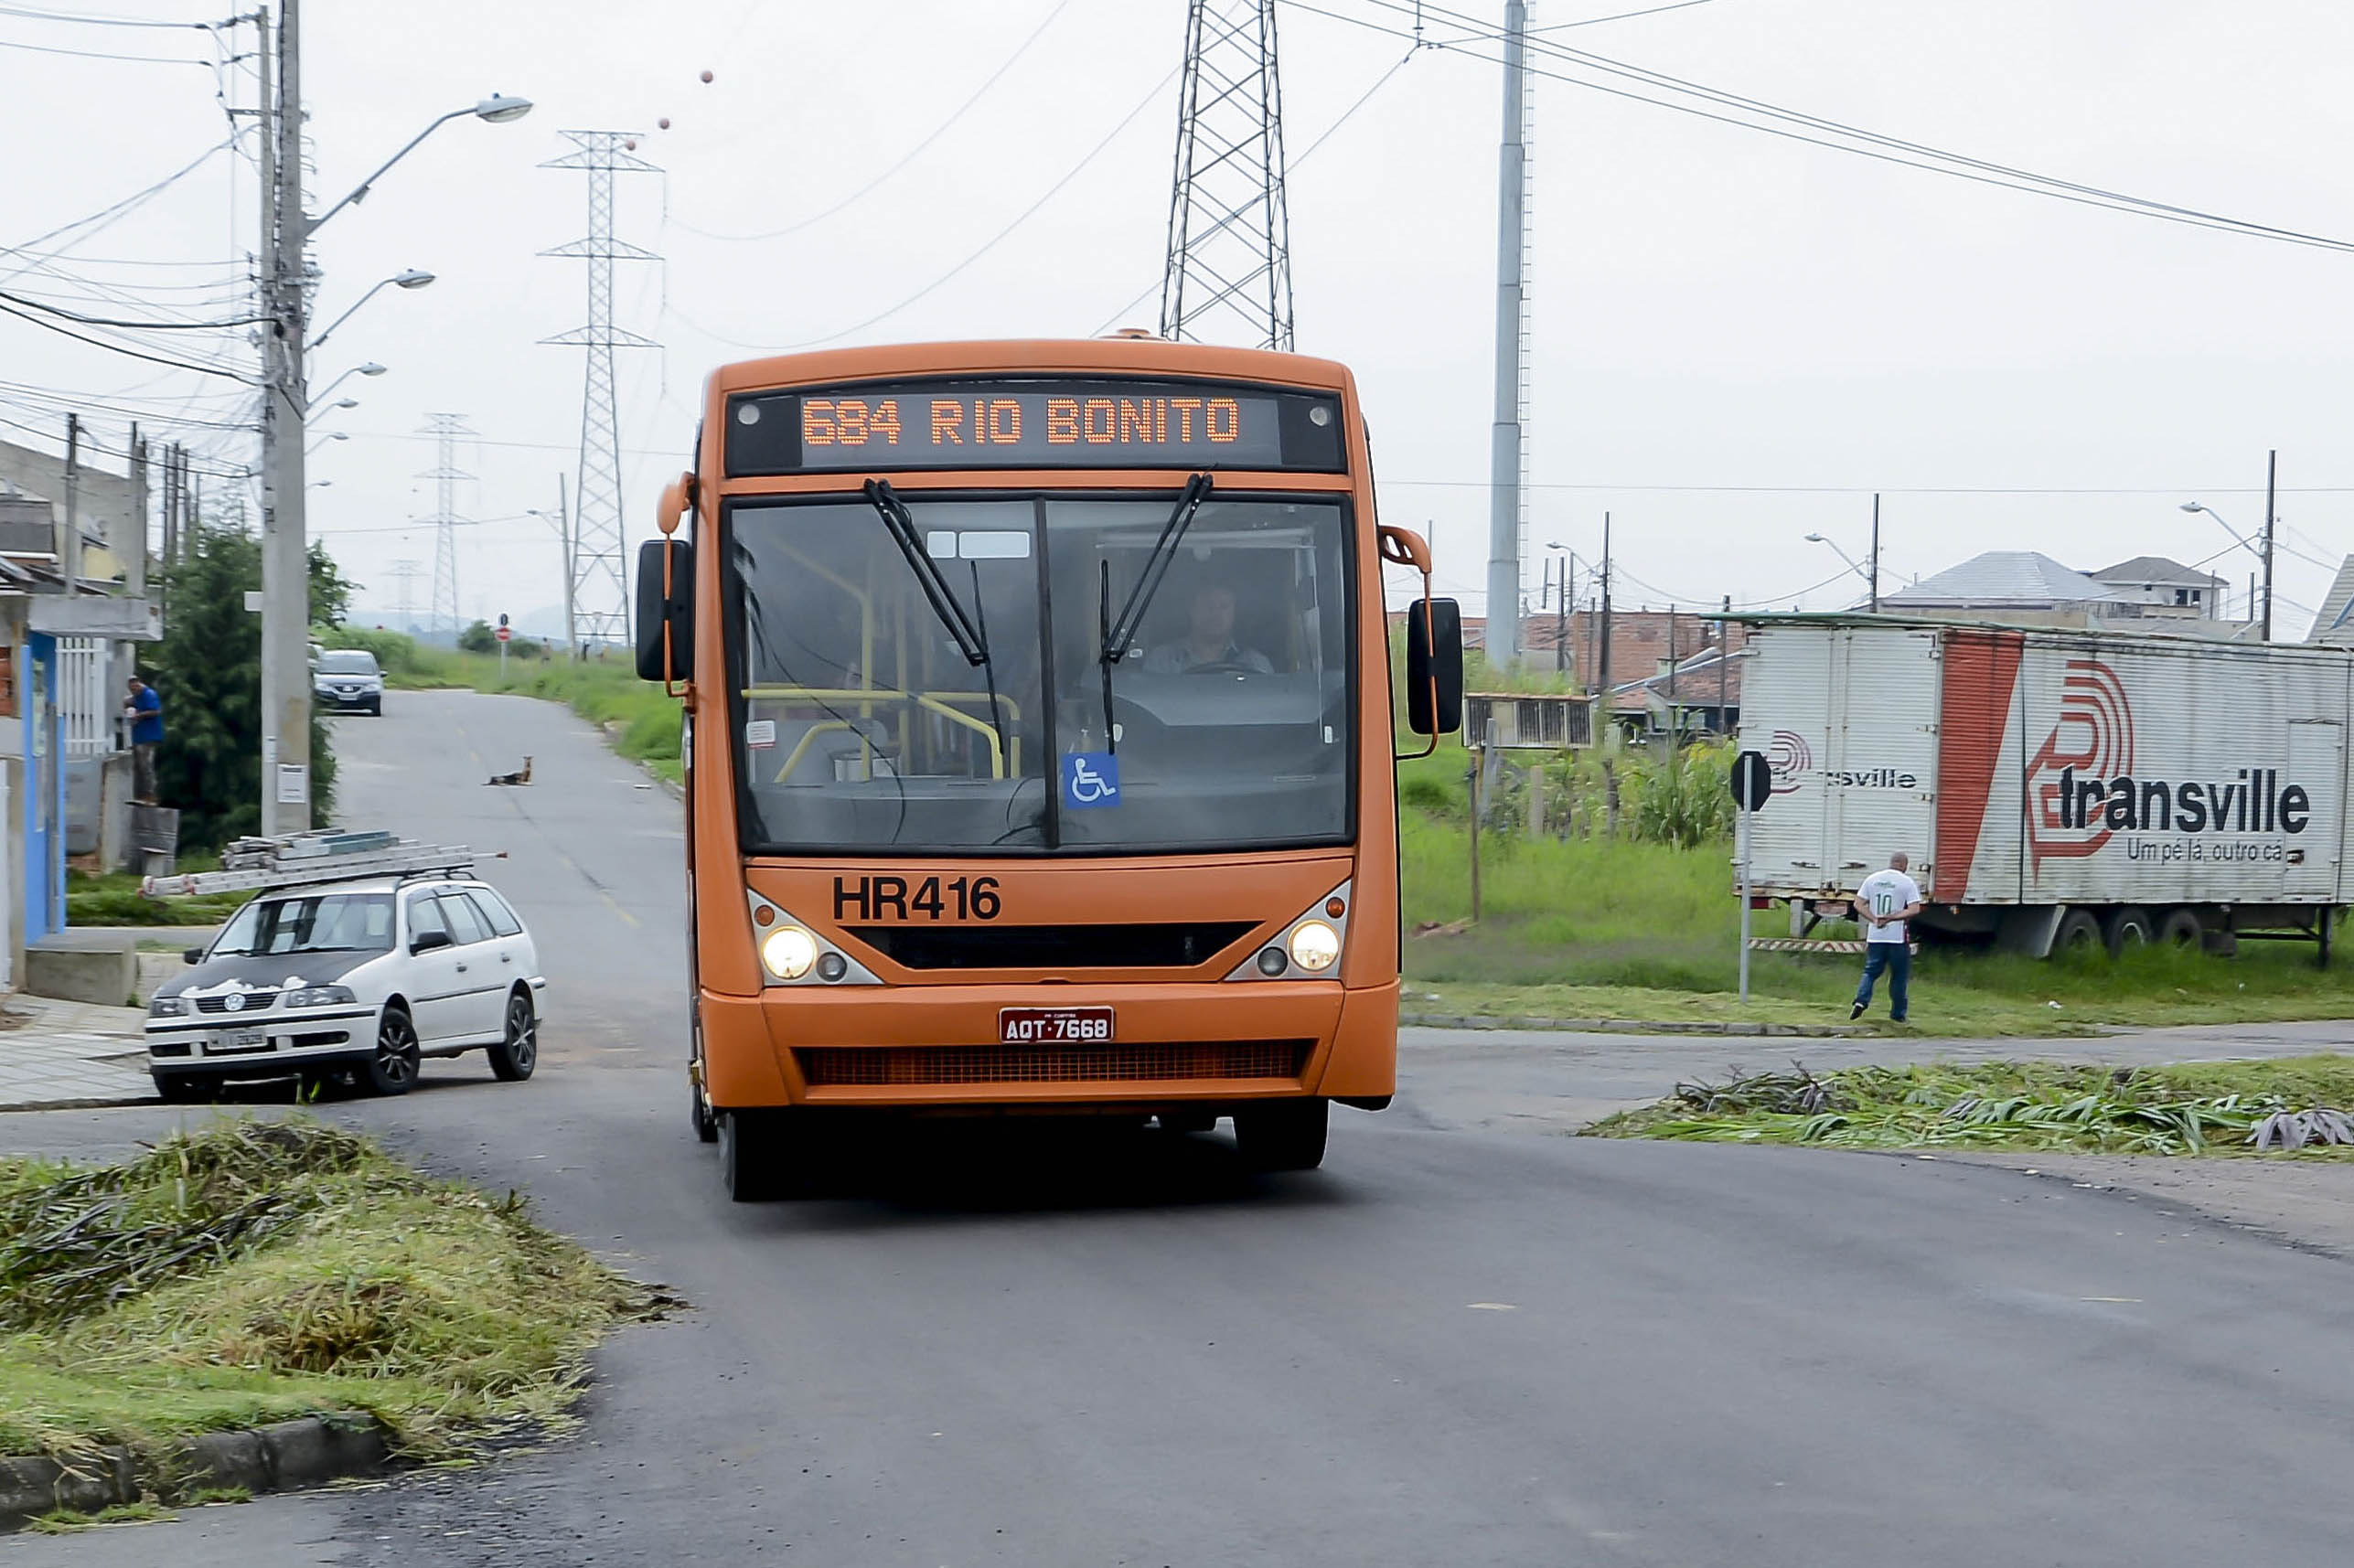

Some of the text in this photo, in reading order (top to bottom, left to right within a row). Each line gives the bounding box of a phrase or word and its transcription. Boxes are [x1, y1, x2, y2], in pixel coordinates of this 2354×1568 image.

[803, 398, 1238, 445] 684 RIO BONITO
[2060, 764, 2310, 834] transville
[2127, 837, 2156, 861] Um
[2162, 837, 2182, 866] pé
[2212, 840, 2257, 861] outro
[2263, 839, 2282, 861] cá
[833, 877, 1001, 920] HR416
[1875, 893, 1892, 915] 10
